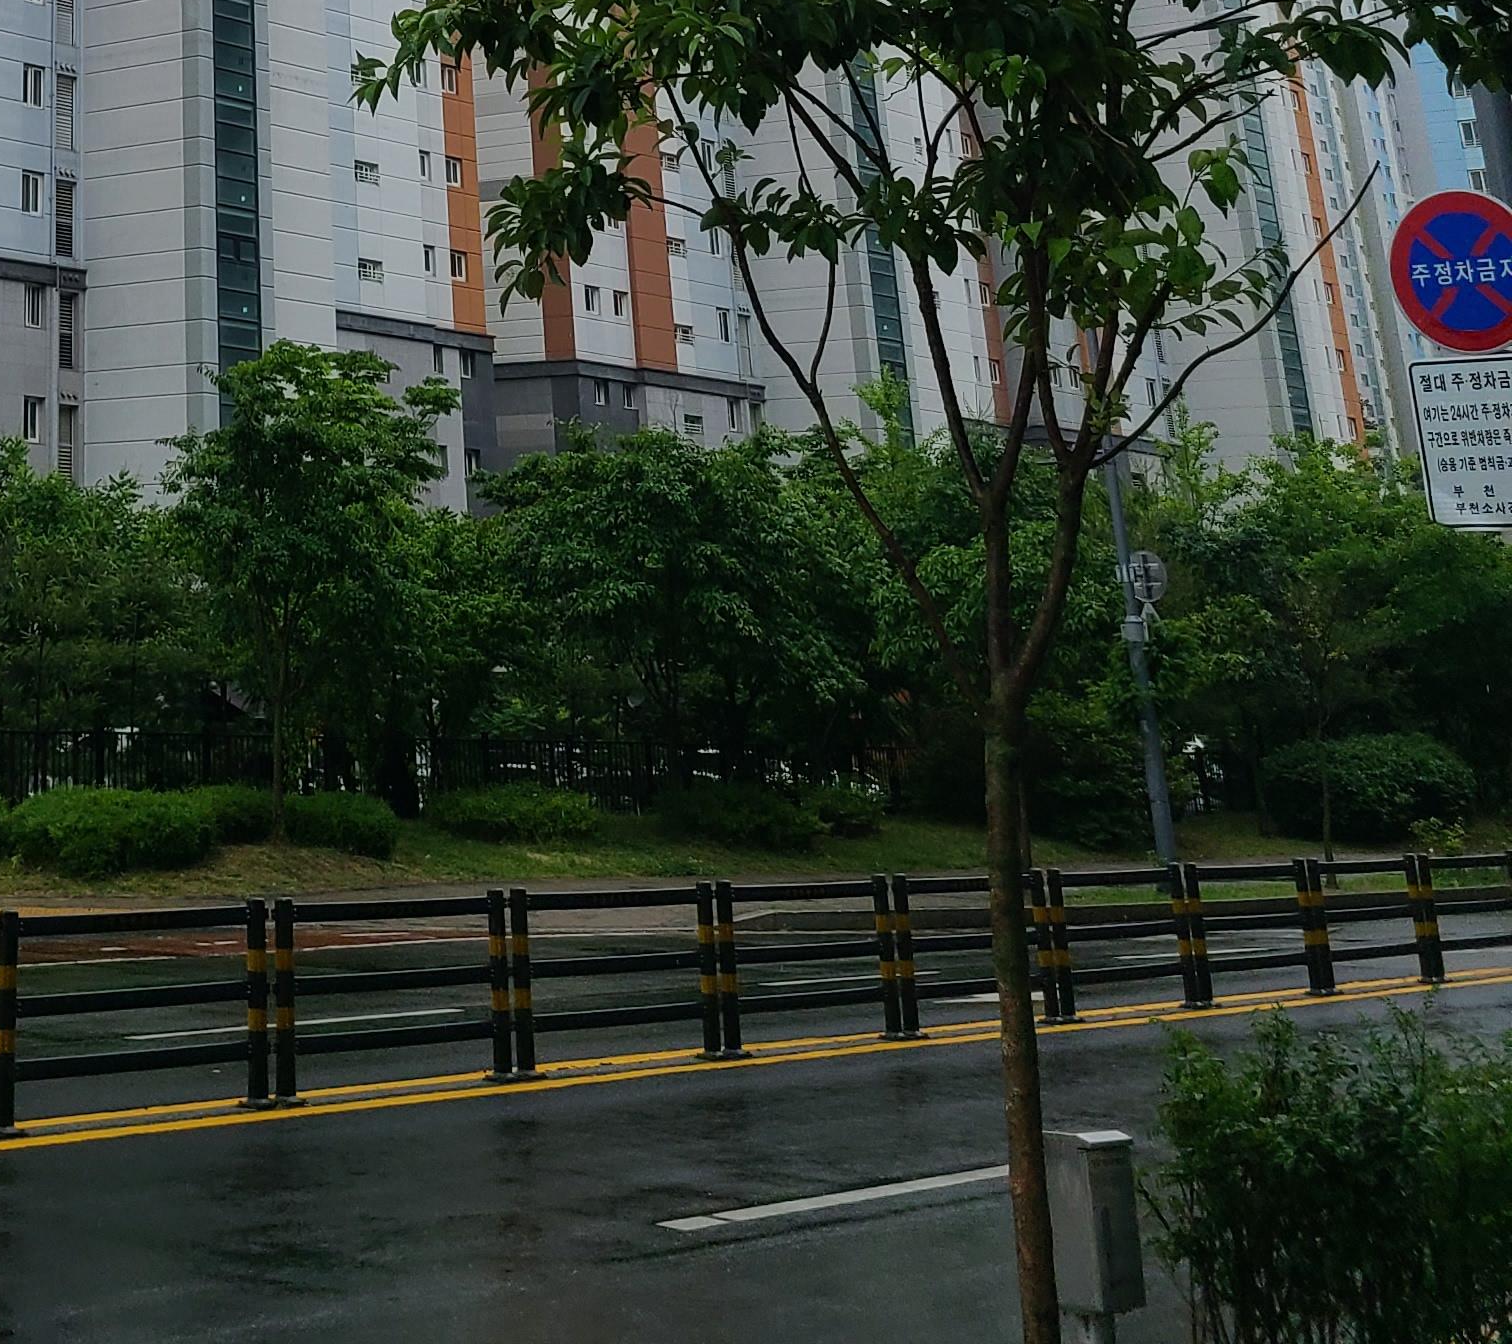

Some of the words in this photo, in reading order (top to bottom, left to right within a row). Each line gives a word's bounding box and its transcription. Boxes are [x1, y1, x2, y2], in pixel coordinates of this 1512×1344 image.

[1419, 373, 1447, 393] 절대
[1451, 370, 1512, 392] 주·정차금
[1423, 404, 1449, 423] 여기는
[1450, 403, 1479, 421] 24시간
[1427, 431, 1460, 449] 구간으로
[1459, 456, 1477, 471] 기준
